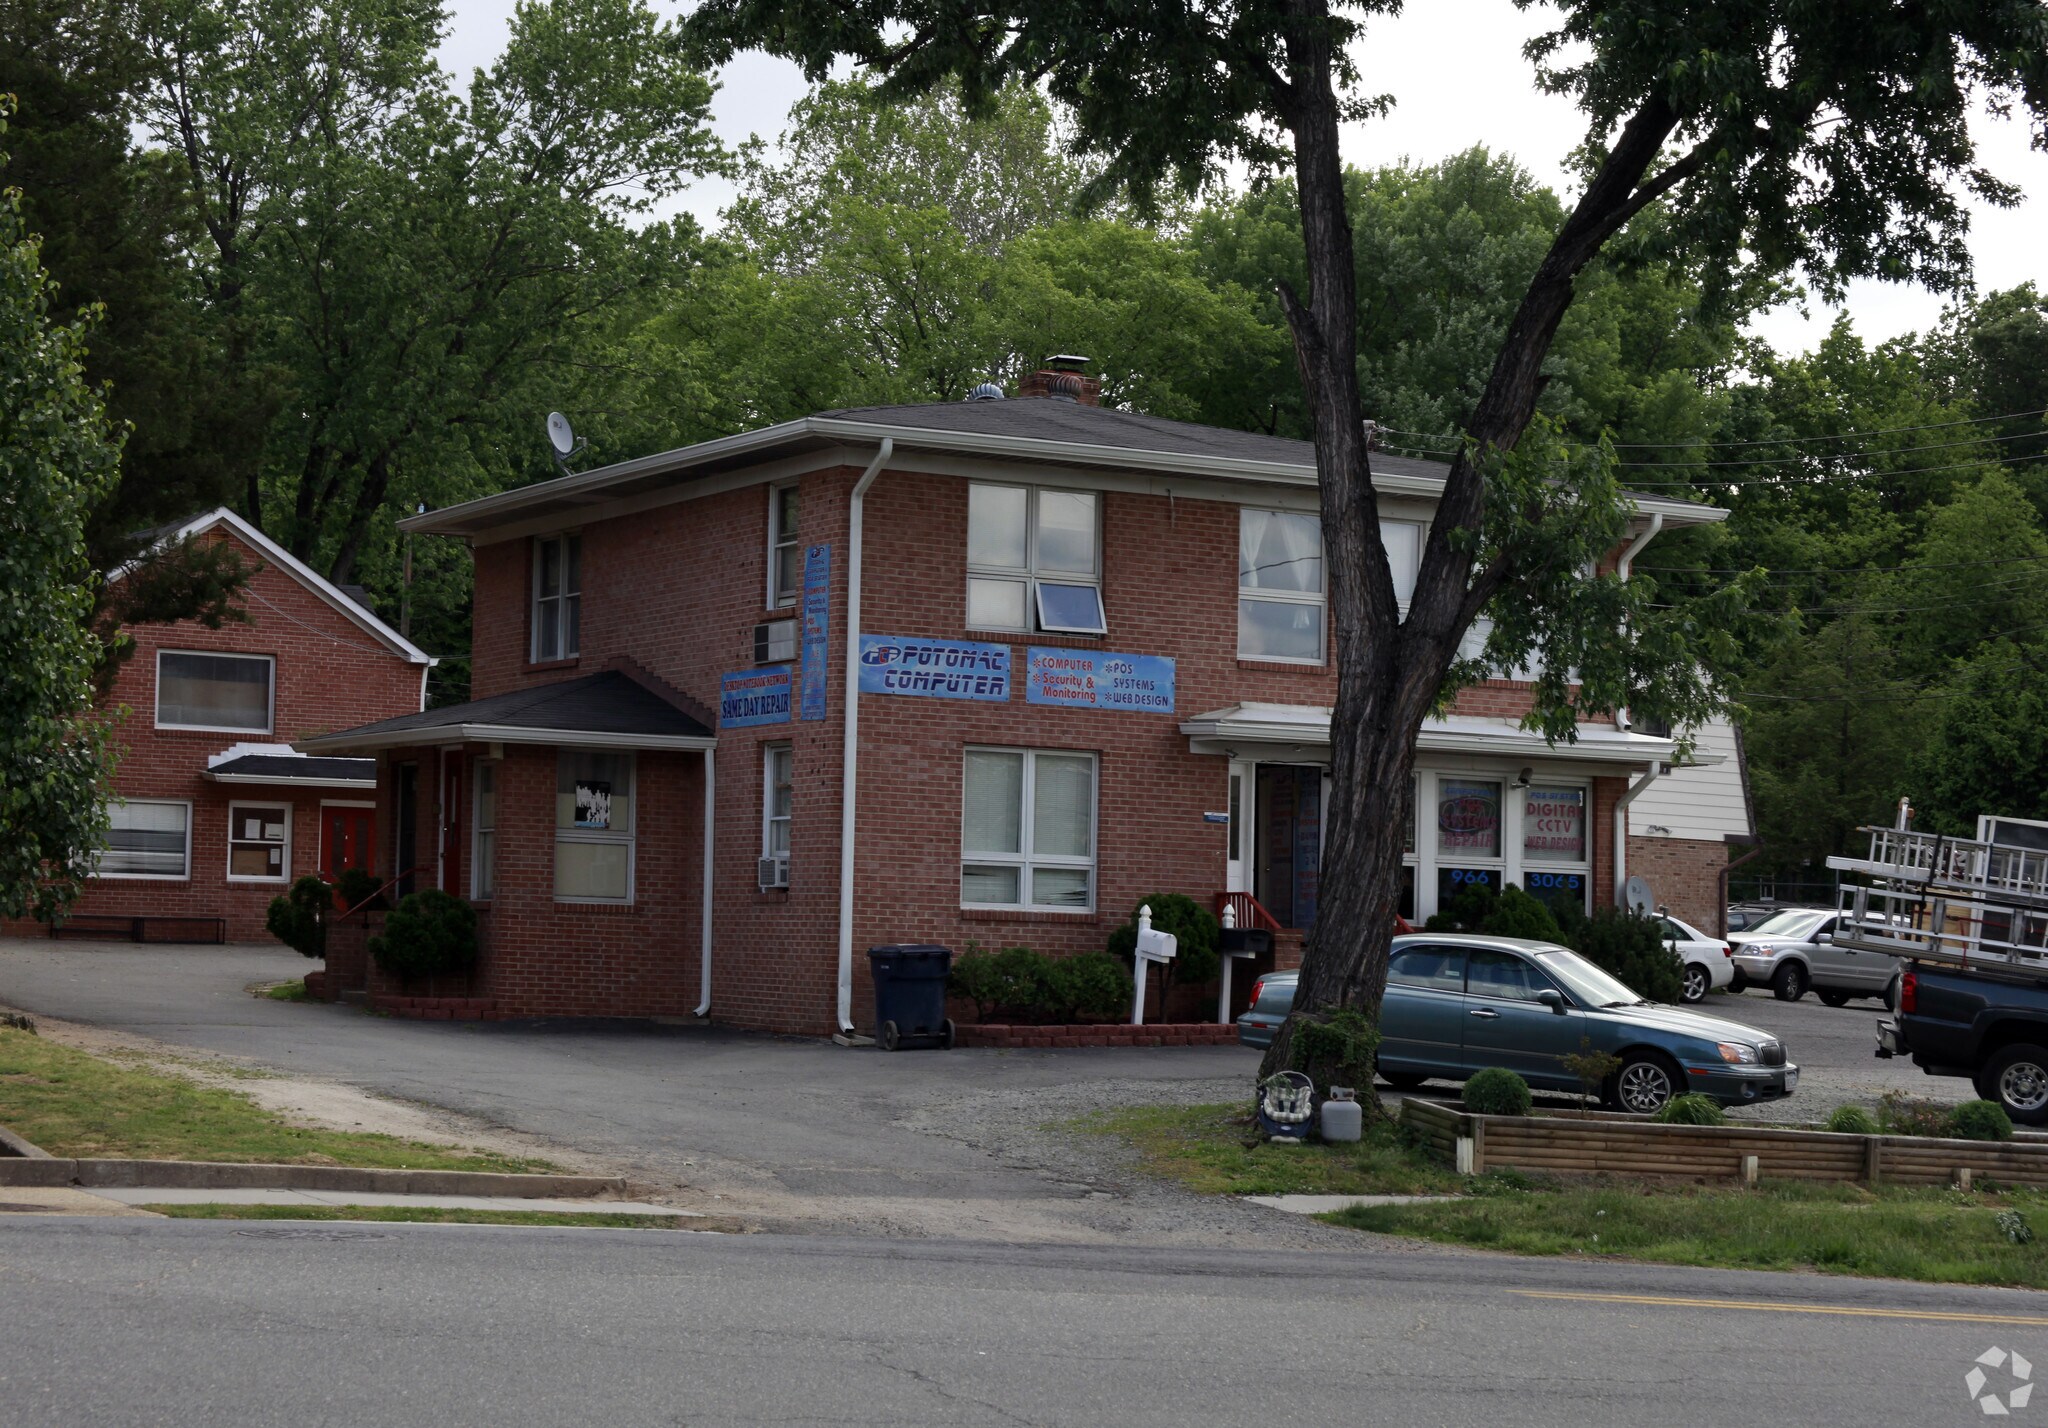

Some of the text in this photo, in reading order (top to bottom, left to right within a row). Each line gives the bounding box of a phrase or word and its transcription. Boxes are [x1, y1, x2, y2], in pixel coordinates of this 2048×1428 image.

[902, 645, 1005, 671] POTOMAC
[1042, 657, 1093, 672] COMPUTER
[1113, 662, 1133, 675] POS
[884, 669, 1005, 695] COMPUTER
[1043, 672, 1095, 689] Security &
[1113, 677, 1155, 691] SYSTEMS
[1042, 685, 1096, 703] Monitoring
[1113, 692, 1169, 707] WEB DESIGN
[722, 693, 789, 719] SAME DAY REPAIR
[1526, 802, 1583, 818] DIGITAL
[1537, 818, 1572, 833] CCTV
[1444, 831, 1493, 849] REPAIR
[1526, 835, 1584, 851] WEB DESIGN
[1451, 869, 1489, 885] 966
[1530, 873, 1580, 889] 3065
